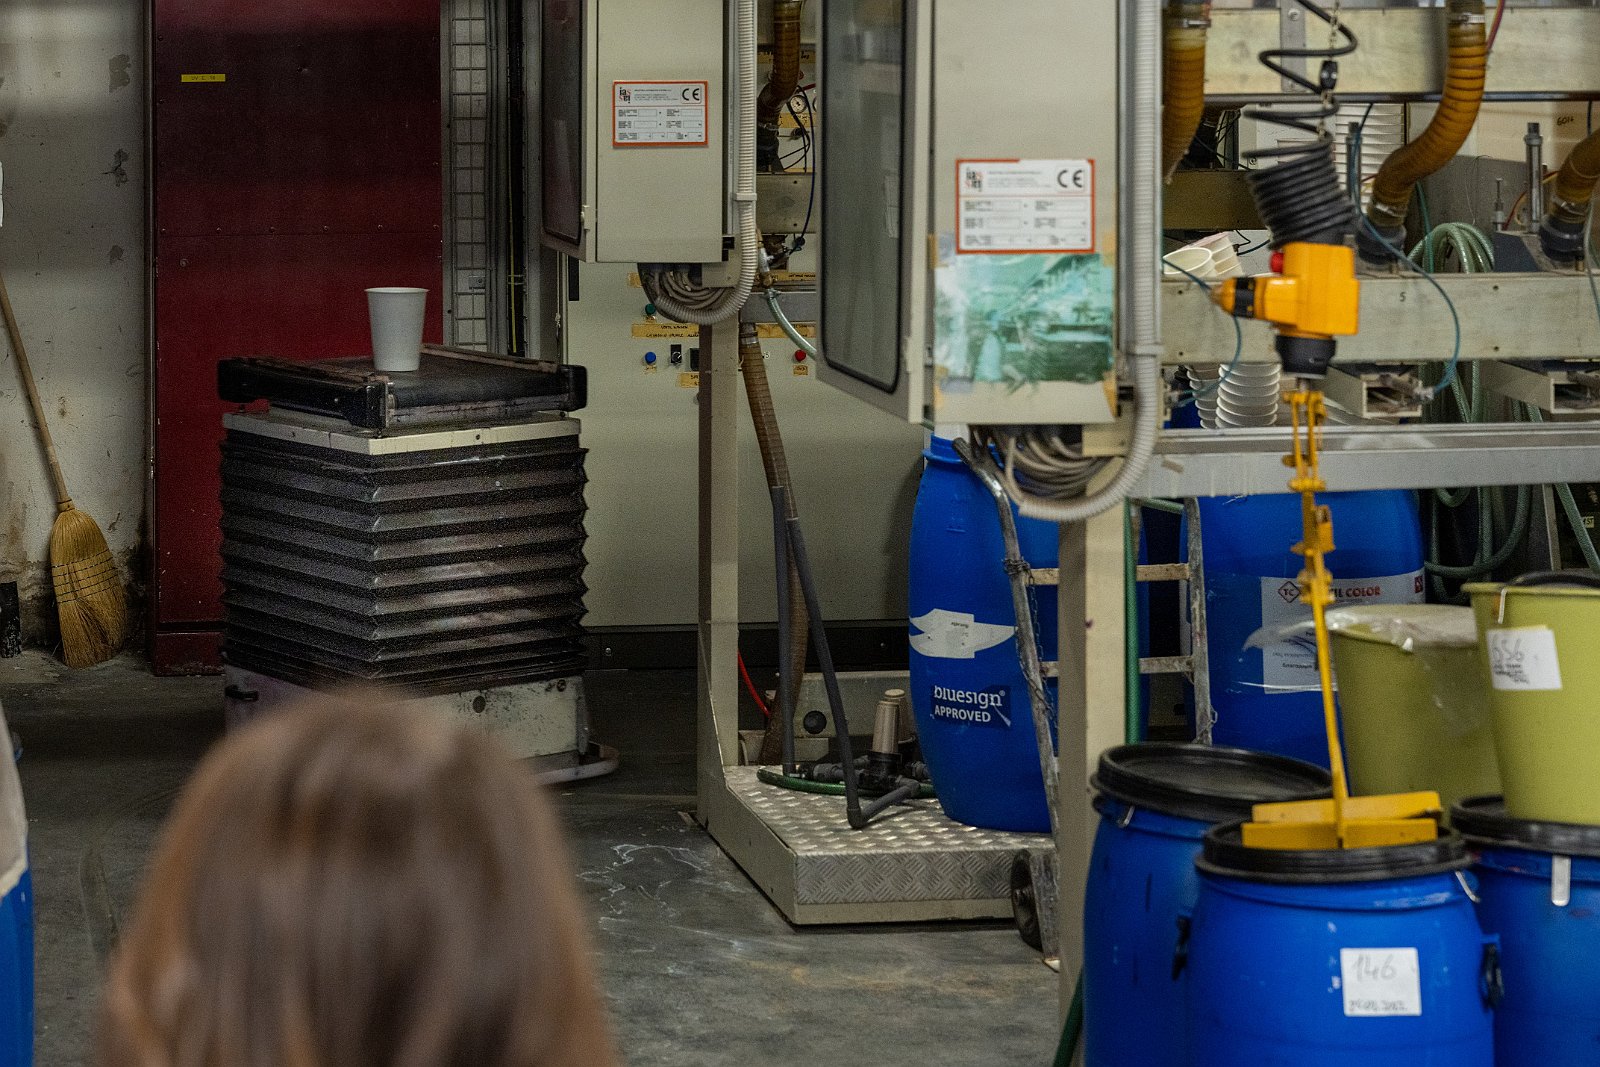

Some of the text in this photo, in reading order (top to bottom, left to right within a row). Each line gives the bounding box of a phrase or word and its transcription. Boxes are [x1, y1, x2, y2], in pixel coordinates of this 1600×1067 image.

[682, 88, 700, 101] CE
[1057, 169, 1083, 188] CE
[1283, 588, 1295, 597] TC
[1346, 586, 1381, 598] COLOR
[934, 704, 991, 722] APPROVED
[1352, 954, 1397, 982] 146
